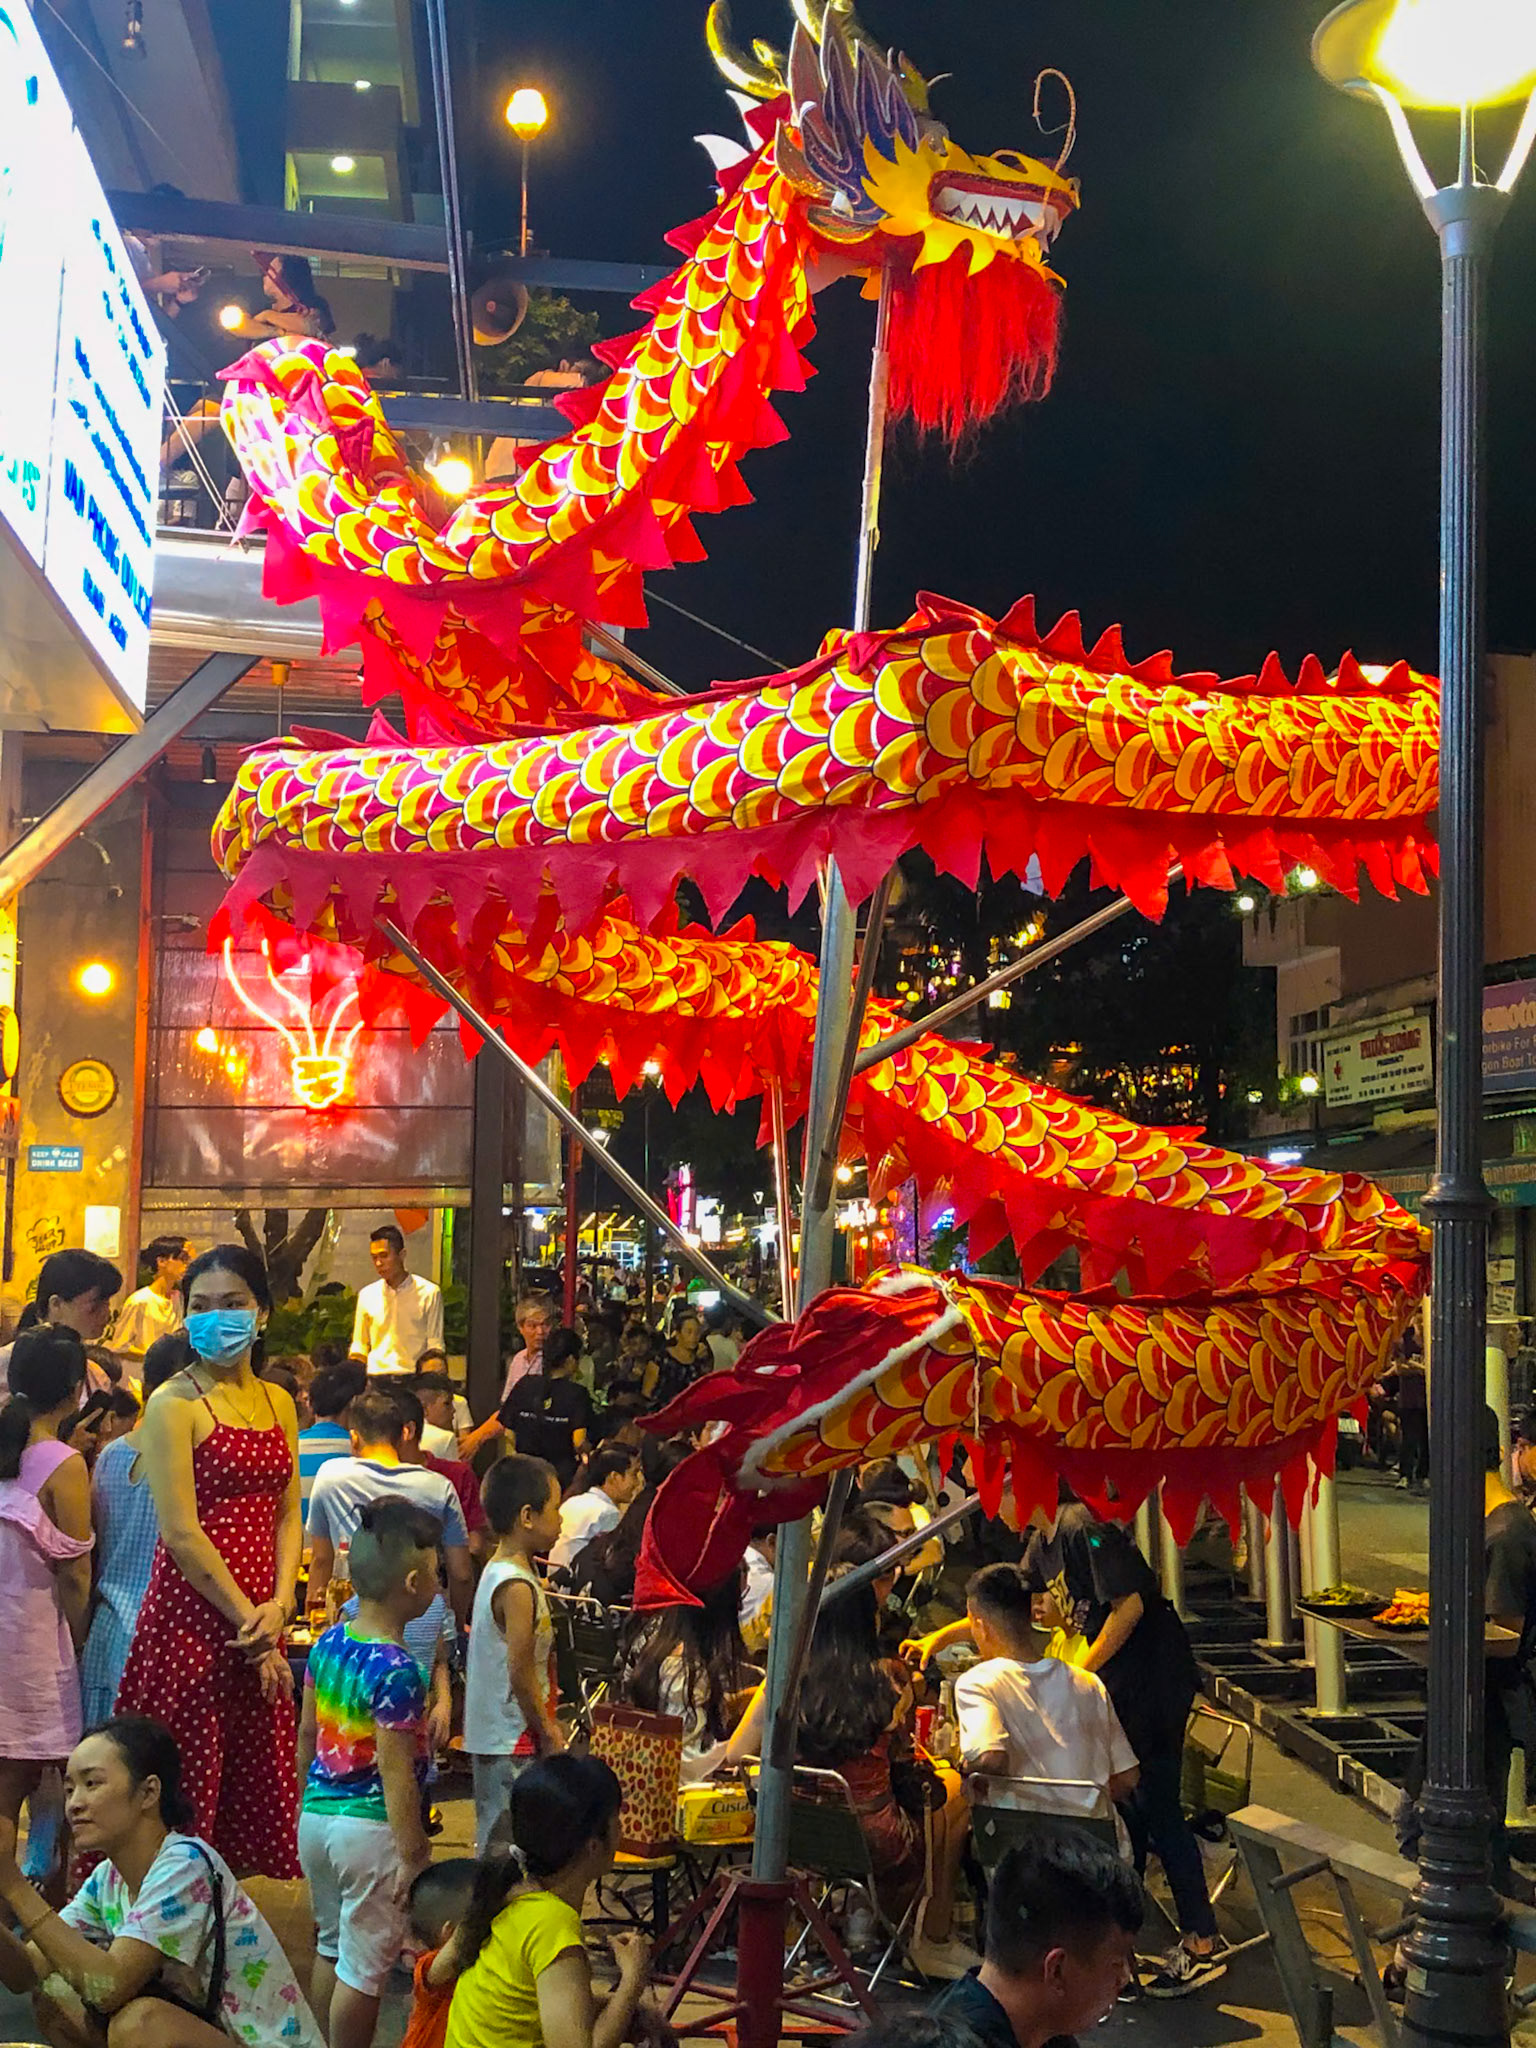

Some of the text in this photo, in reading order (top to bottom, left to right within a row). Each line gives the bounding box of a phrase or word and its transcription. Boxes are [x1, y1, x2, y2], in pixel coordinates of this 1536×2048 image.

[1514, 1036, 1530, 1050] For
[32, 1151, 51, 1159] KEEP
[31, 1159, 79, 1168] DRINK BEER
